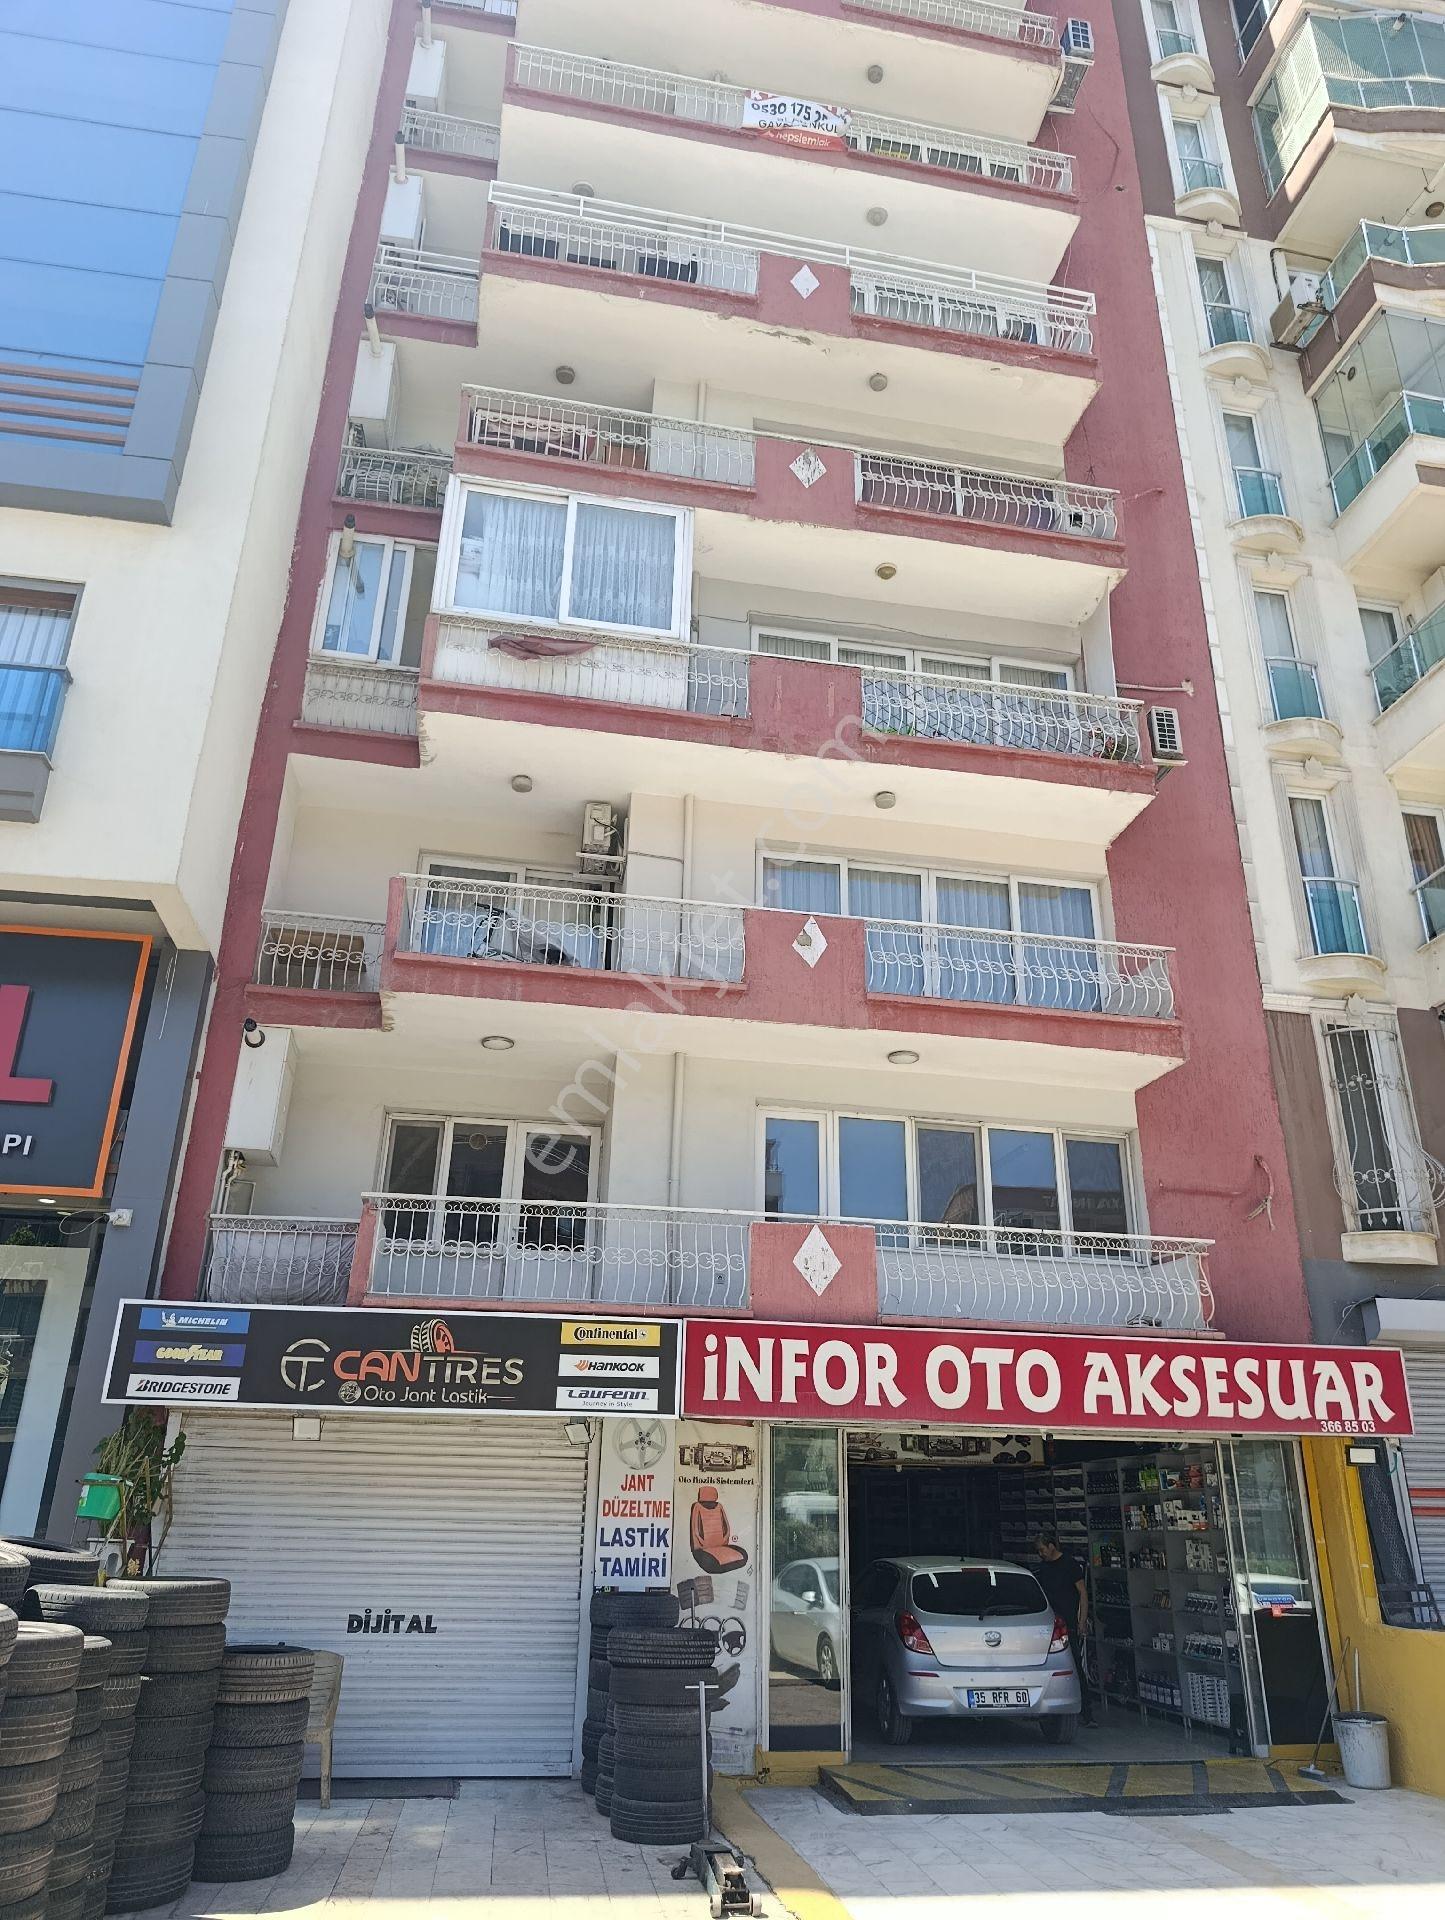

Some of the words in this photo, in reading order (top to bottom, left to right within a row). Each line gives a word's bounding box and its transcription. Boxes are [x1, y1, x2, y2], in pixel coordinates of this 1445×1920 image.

[751, 102, 787, 116] 0530
[790, 102, 811, 121] 175
[177, 1316, 229, 1327] MICHELIN
[573, 1327, 639, 1341] Continental
[156, 1344, 224, 1363] GOODYEAR
[135, 1379, 232, 1395] BRIDGESTONE
[924, 1343, 1062, 1413] OTO
[1082, 1351, 1397, 1422] AKSESUAR
[363, 1385, 396, 1402] Oto
[400, 1386, 436, 1403] Jant
[441, 1388, 488, 1404] Lastik
[1320, 1420, 1343, 1433] 366
[1344, 1421, 1359, 1433] 85
[1361, 1421, 1376, 1433] 03
[621, 1474, 655, 1492] JANT
[678, 1475, 692, 1484] Oto
[716, 1476, 754, 1485] Sistemleri
[602, 1496, 671, 1518] DÜZELTME
[599, 1523, 670, 1548] LASTİK
[599, 1553, 667, 1578] TAMİRİ
[346, 1608, 438, 1634] DİJİTAL
[974, 1691, 986, 1704] 35
[992, 1691, 1009, 1704] RFR
[1016, 1691, 1028, 1704] 60
